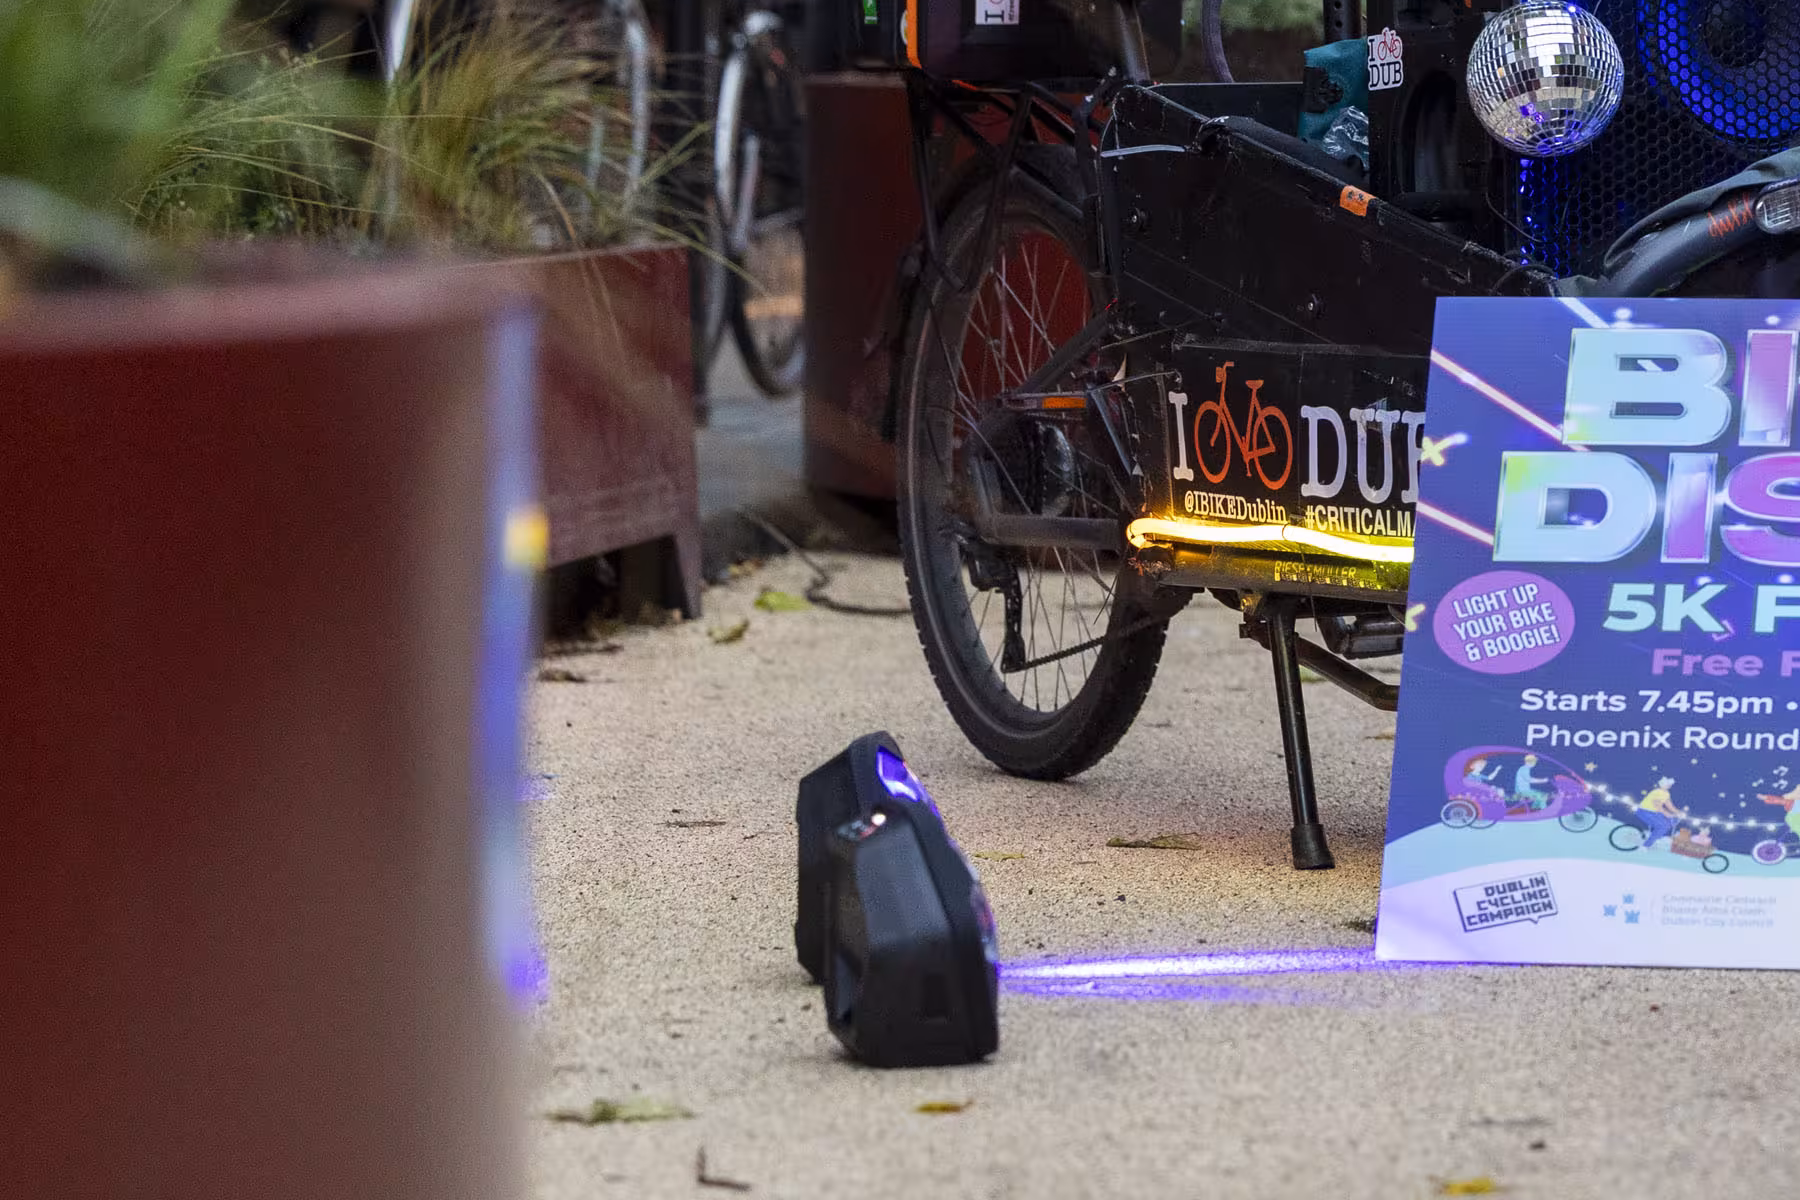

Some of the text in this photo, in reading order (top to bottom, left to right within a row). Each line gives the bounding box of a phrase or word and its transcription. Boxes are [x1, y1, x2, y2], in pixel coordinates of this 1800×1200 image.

[985, 10, 1005, 23] I
[1368, 39, 1376, 62] I
[1369, 61, 1402, 88] DUB
[1168, 391, 1194, 482] I
[1184, 490, 1289, 525] @IBIKEDublin
[1305, 504, 1416, 538] #CRITICALM
[1453, 583, 1539, 618] LIGHT UP
[1602, 582, 1729, 633] 5K
[1453, 602, 1557, 641] YOUR BIKE
[1465, 624, 1561, 662] & BOOGIE!
[1652, 648, 1764, 676] Free
[1520, 688, 1627, 712] Starts
[1638, 690, 1774, 718] 7.45pm
[1526, 723, 1672, 749] Phoenix
[1476, 888, 1550, 911] CYCLING
[1484, 876, 1547, 897] DUBLIN
[1466, 900, 1553, 926] CAMPAIGN
